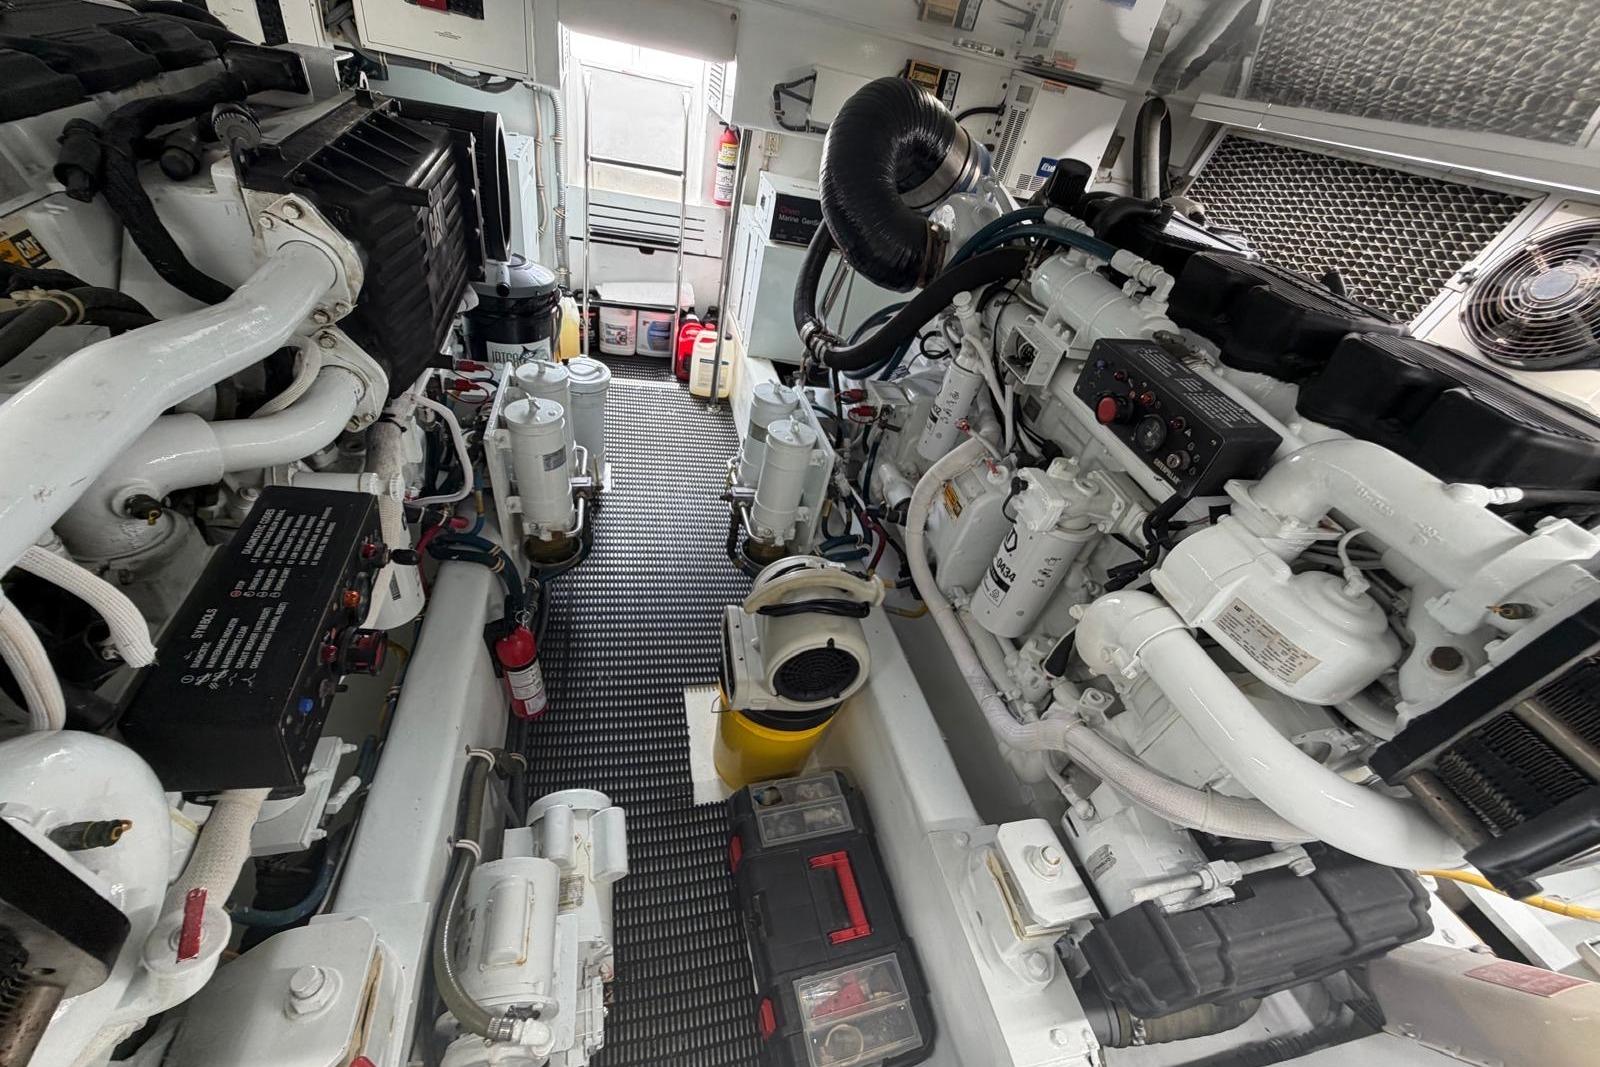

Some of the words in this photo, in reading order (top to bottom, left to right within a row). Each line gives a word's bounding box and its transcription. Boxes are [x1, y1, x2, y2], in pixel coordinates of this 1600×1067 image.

[778, 214, 800, 223] Marine
[241, 522, 266, 554] DIAGNOSTIC
[260, 508, 276, 524] CODES
[191, 608, 218, 639] SYMBOLS
